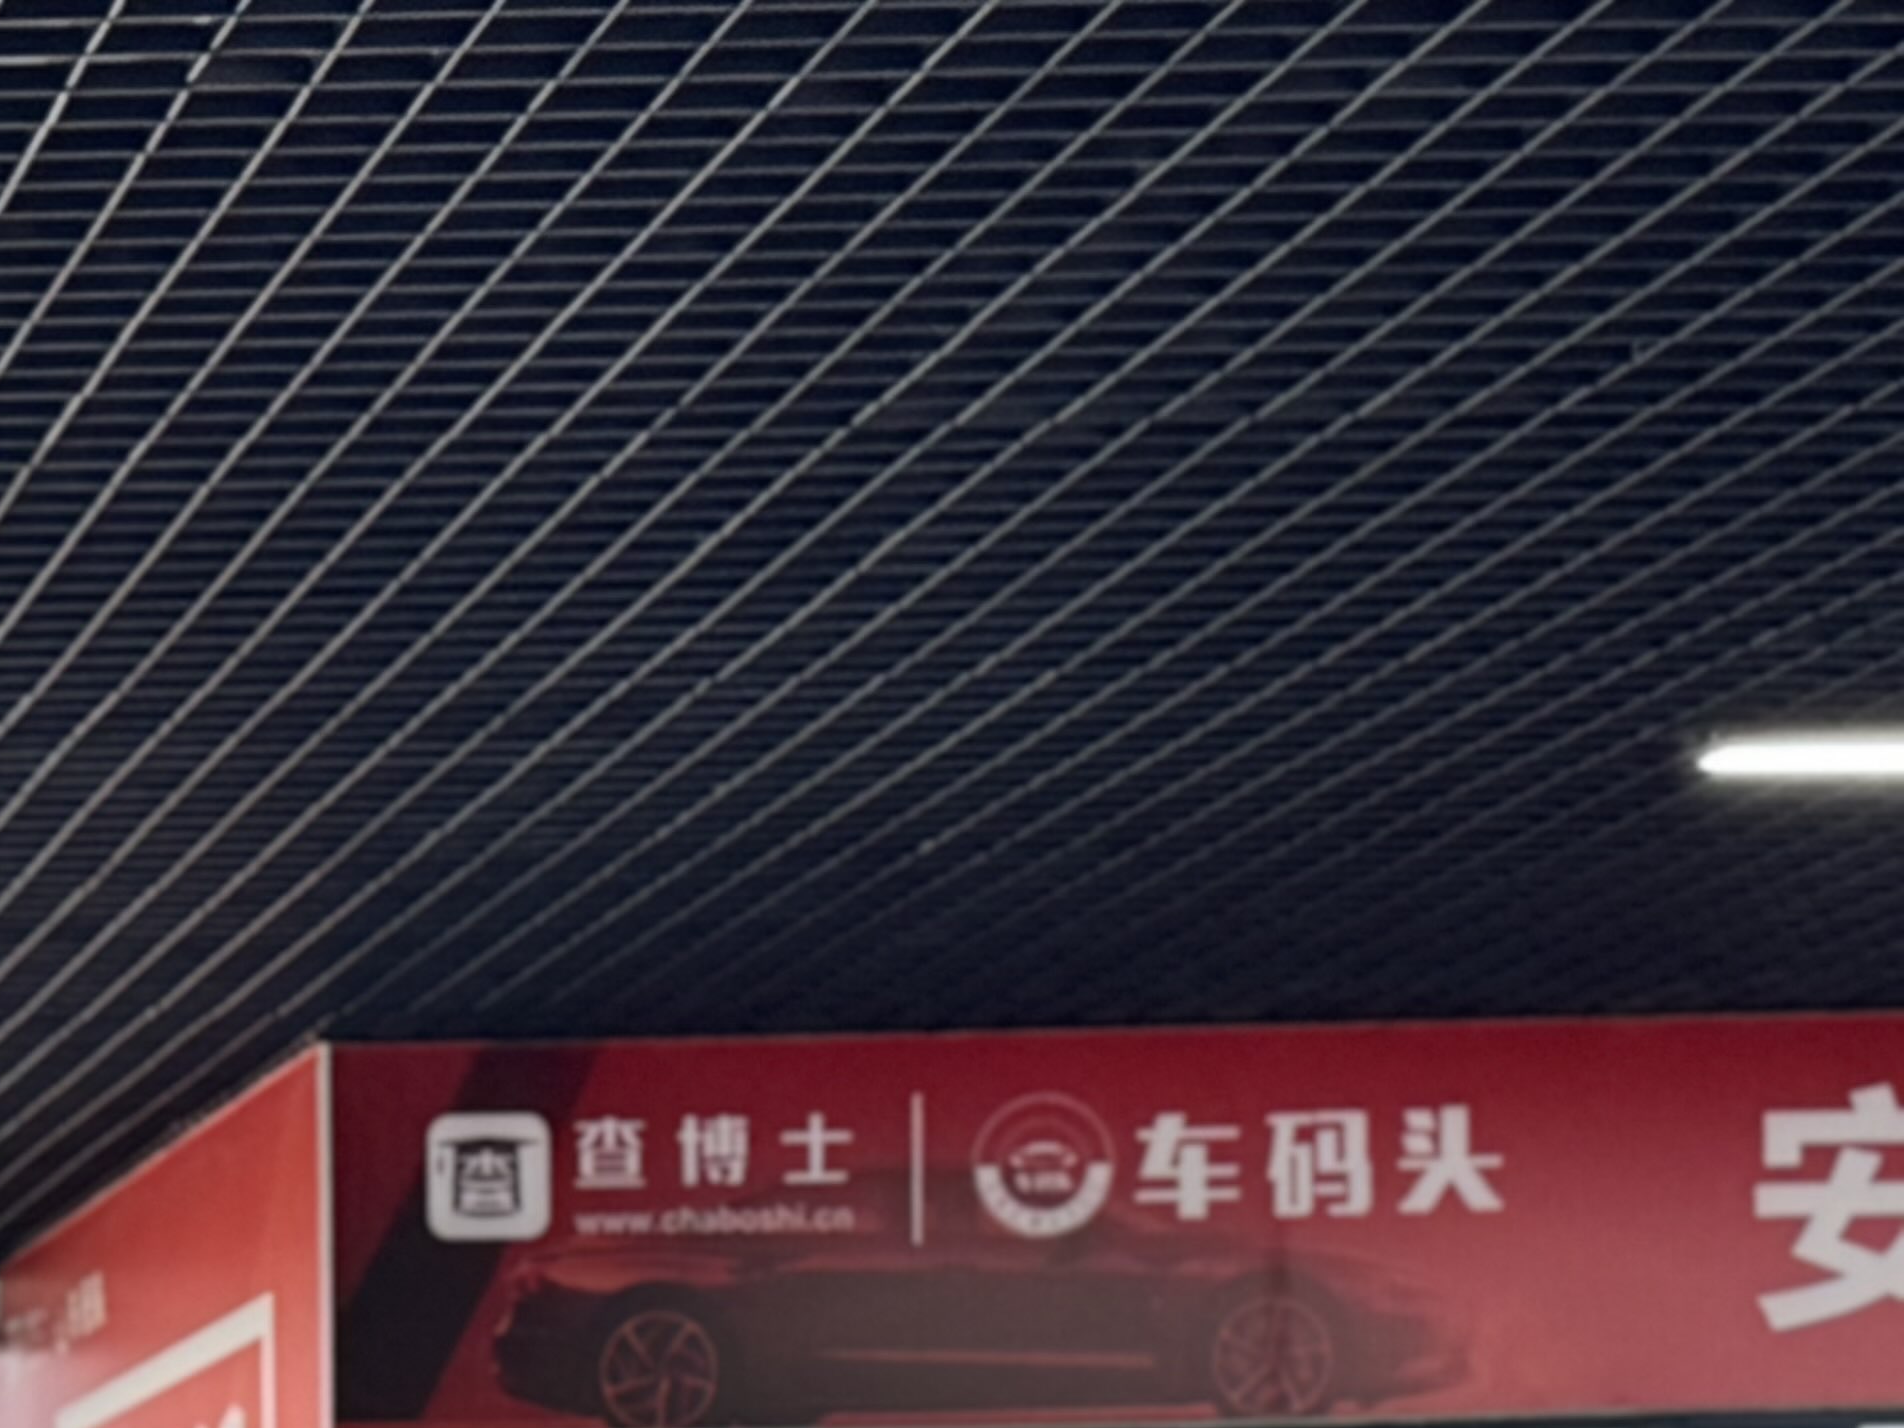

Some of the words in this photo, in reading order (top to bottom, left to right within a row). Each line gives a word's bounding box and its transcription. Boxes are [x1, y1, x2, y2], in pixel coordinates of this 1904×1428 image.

[573, 1112, 855, 1189] 查博士
[1135, 1105, 1504, 1220] 车码头
[574, 1205, 854, 1234] www.chaboshi.cn
